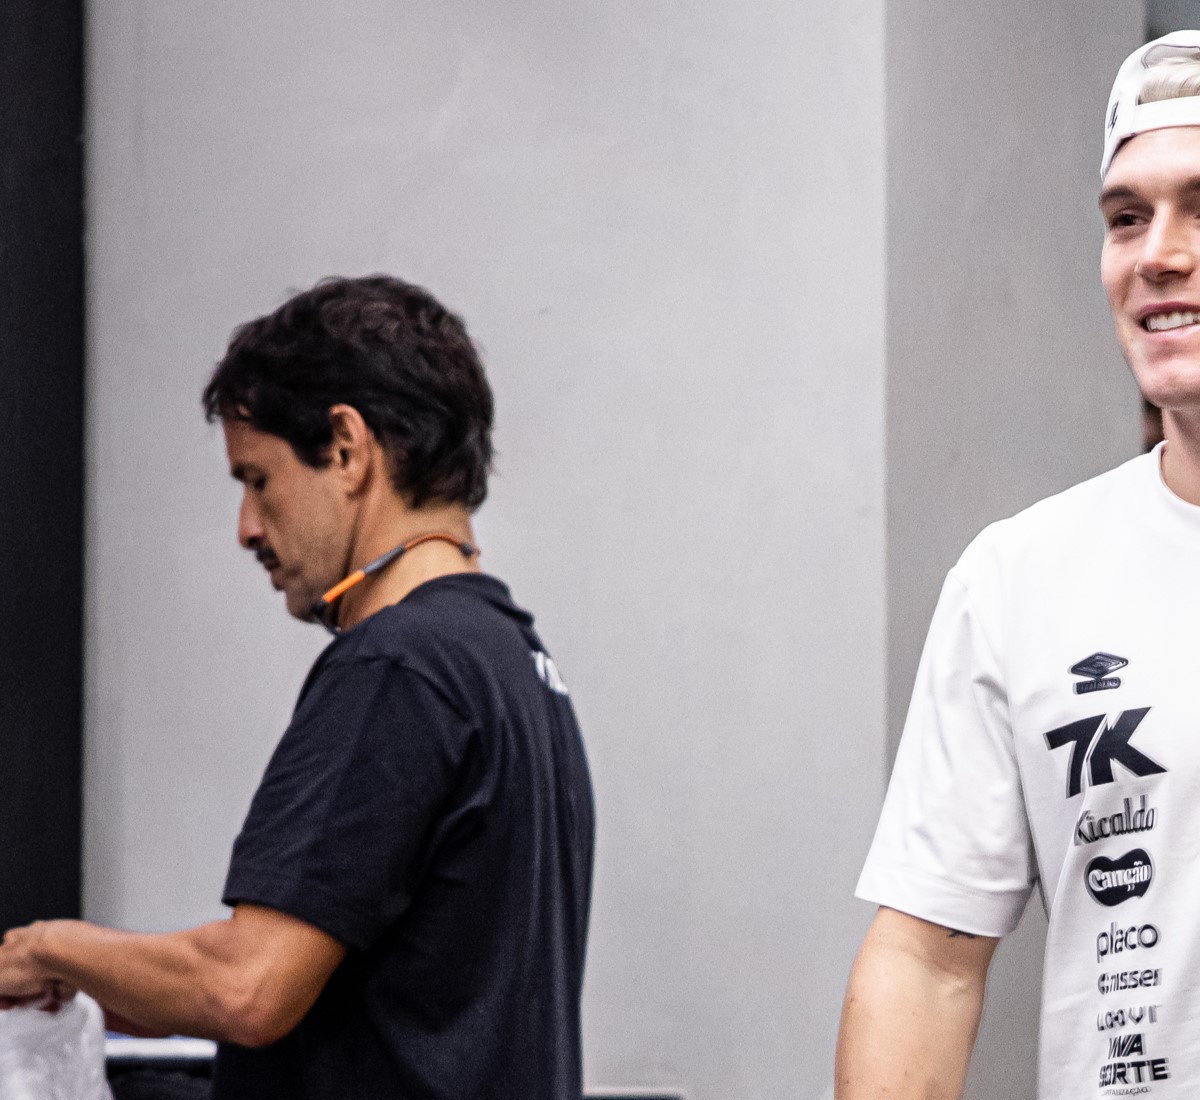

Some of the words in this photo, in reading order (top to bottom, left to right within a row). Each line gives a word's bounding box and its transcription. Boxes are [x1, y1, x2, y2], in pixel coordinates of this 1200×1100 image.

[1043, 706, 1169, 799] 7K
[1073, 794, 1157, 846] Kicaldo
[1089, 860, 1152, 892] Canção
[1096, 921, 1162, 964] placo
